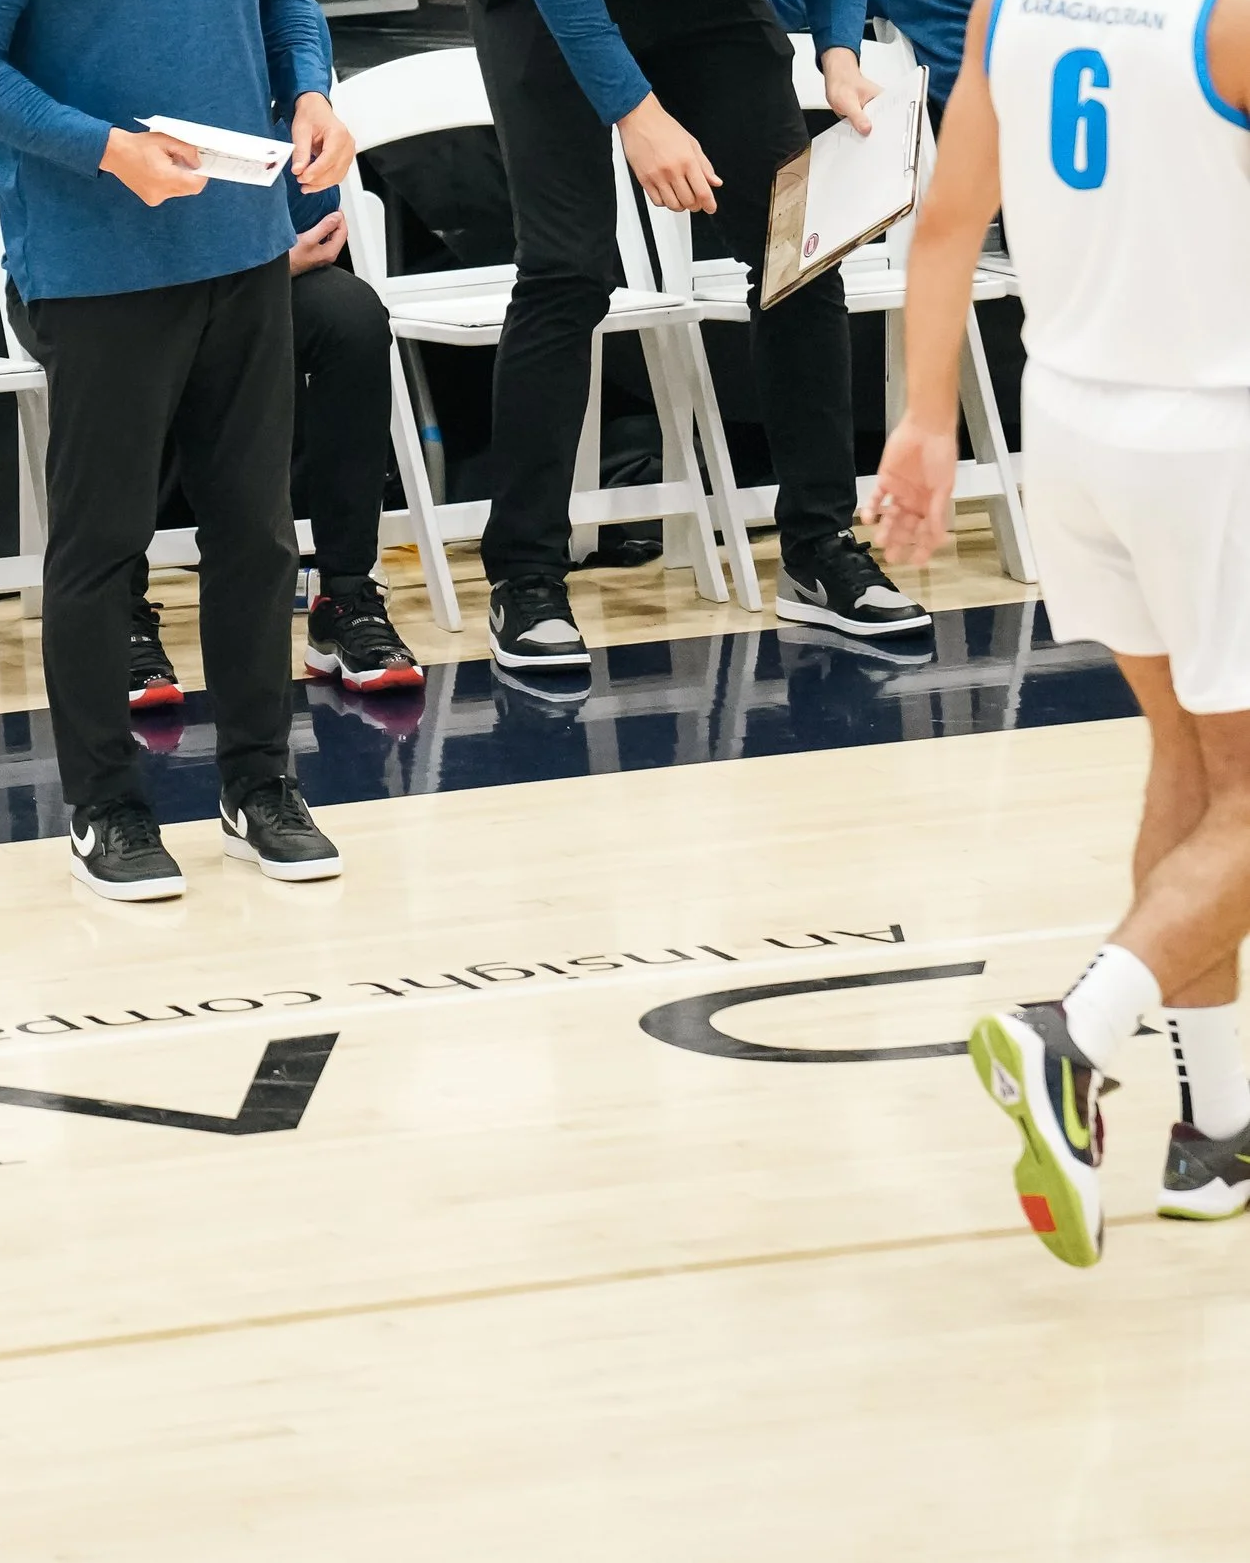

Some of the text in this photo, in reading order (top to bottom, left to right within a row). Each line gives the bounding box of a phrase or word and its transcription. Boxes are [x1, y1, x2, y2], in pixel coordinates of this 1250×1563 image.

[1051, 49, 1110, 190] 6
[763, 924, 905, 949] An
[348, 945, 738, 998] Insight
